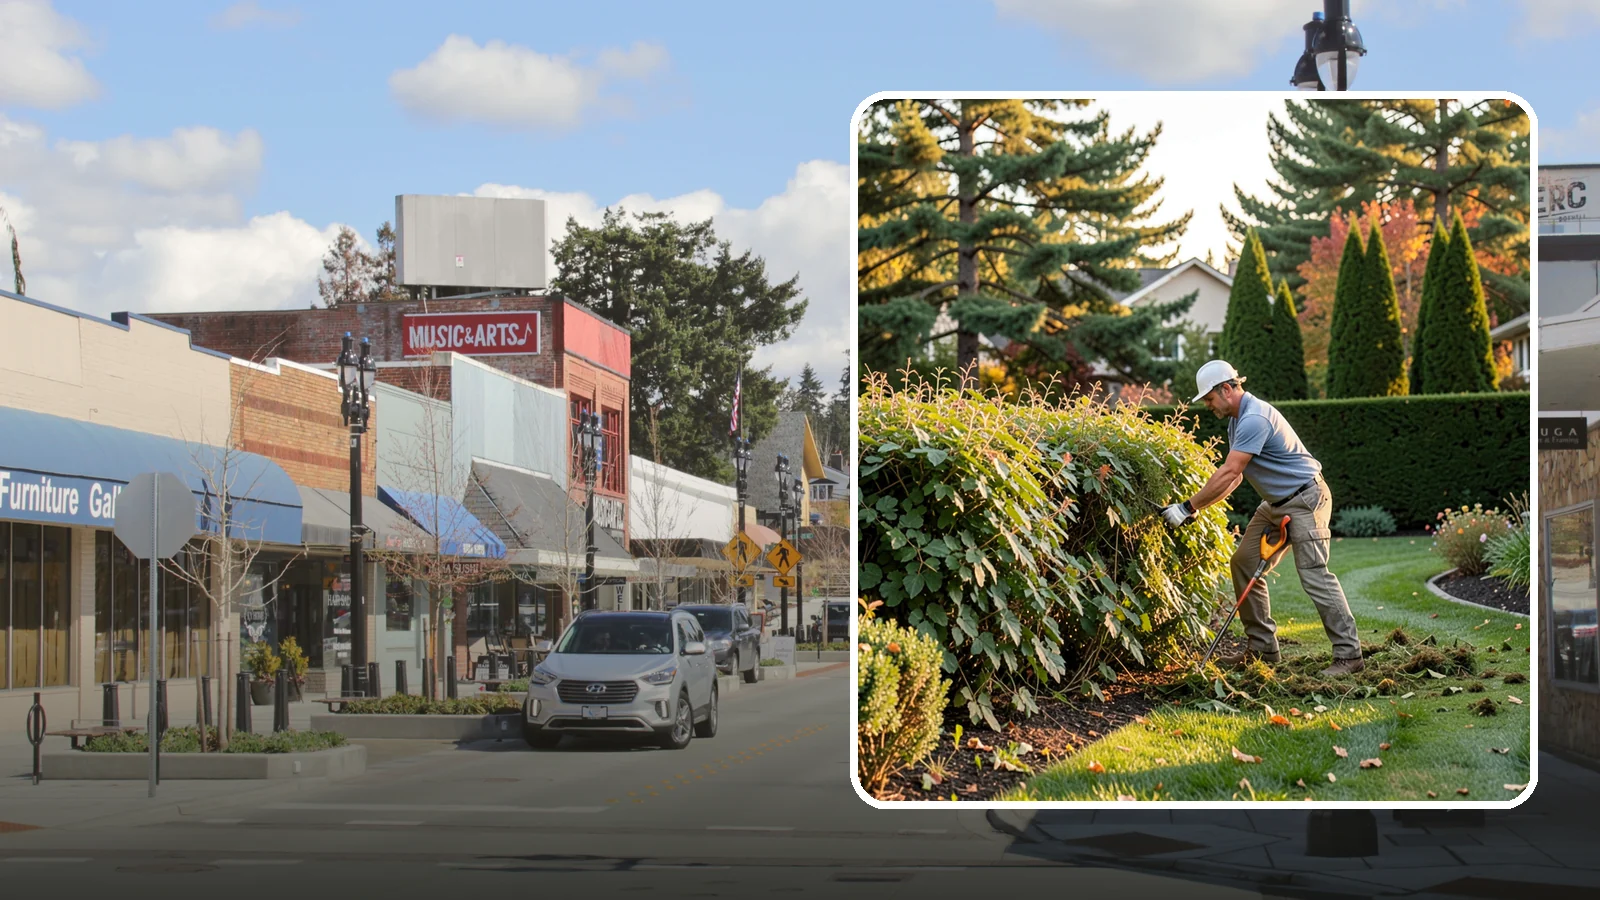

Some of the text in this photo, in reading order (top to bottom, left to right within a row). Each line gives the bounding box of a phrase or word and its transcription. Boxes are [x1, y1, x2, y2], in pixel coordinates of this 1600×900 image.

[0, 471, 122, 520] Furniture Gal
[453, 563, 480, 574] SUSHI
